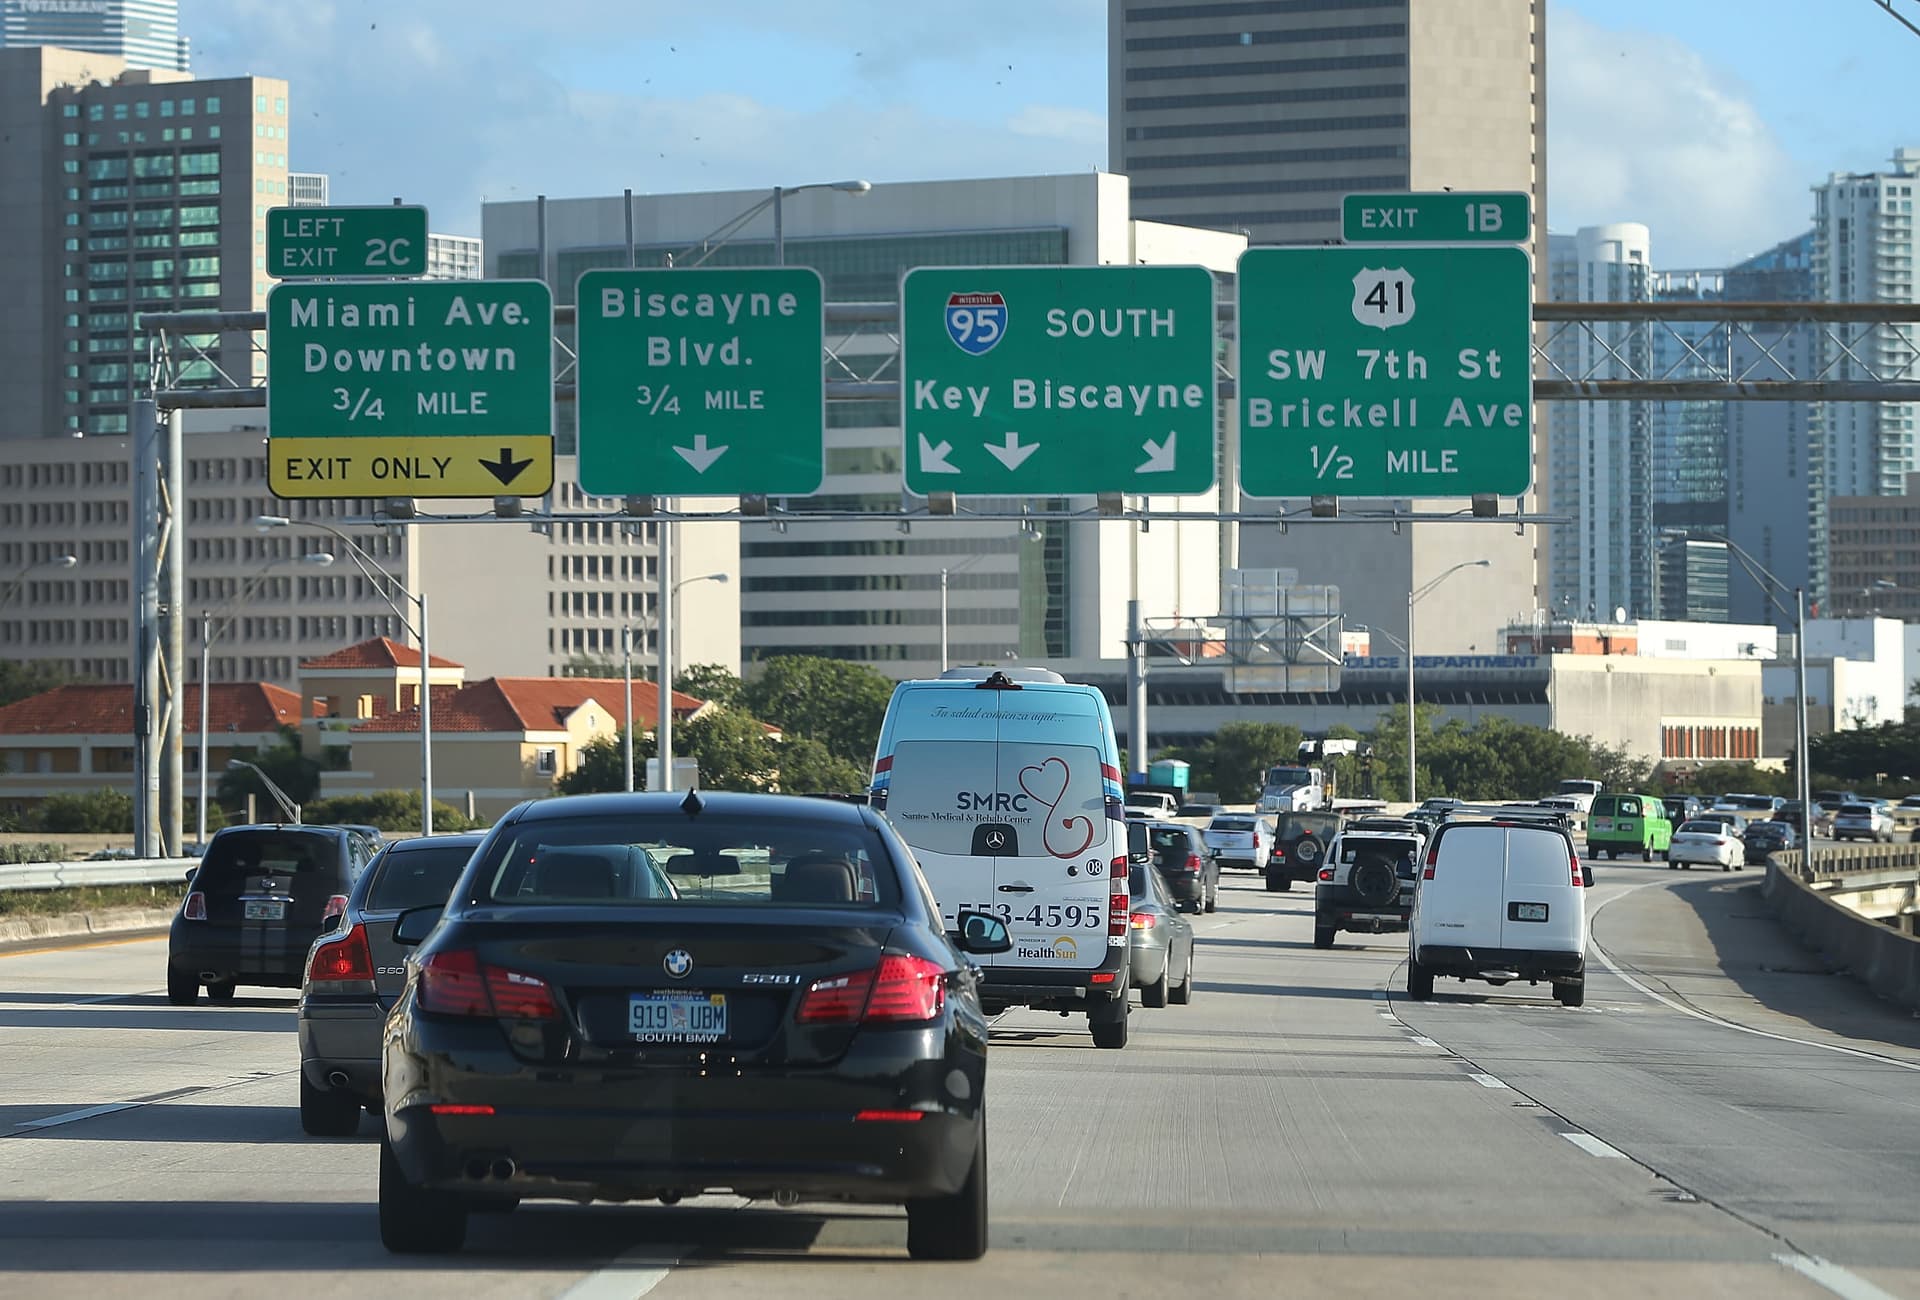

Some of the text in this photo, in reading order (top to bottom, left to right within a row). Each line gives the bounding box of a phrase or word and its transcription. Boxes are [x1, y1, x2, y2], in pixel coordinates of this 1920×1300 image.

[284, 218, 344, 237] LEFT
[1362, 204, 1502, 231] EXIT 1B
[284, 239, 409, 266] EXIT 2C
[602, 288, 797, 324] Biscayne
[958, 296, 993, 304] INTERSTATE
[1364, 281, 1403, 313] 41
[292, 297, 529, 327] Miami Ave.
[1047, 309, 1173, 337] SOUTH
[952, 309, 998, 343] 95
[305, 343, 515, 372] Downtown
[648, 337, 752, 366] Blvd.
[1268, 349, 1500, 379] SW 7th St
[334, 388, 487, 420] 3/4 MILE
[638, 385, 763, 415] 3/4 MILE
[915, 379, 1202, 416] Key Biscayne
[1250, 398, 1522, 427] Brickell Ave
[288, 457, 451, 479] EXIT ONLY
[1311, 446, 1458, 478] 1/2 MILE
[1406, 656, 1538, 668] DEPARTMENT
[950, 707, 982, 719] salud
[957, 791, 1028, 812] SMRC
[931, 812, 964, 821] Medical
[976, 813, 1003, 822] Rehab
[1004, 814, 1031, 824] Center
[1087, 861, 1102, 875] 08
[1018, 947, 1077, 959] HealthSun
[377, 967, 405, 975] S60
[633, 1005, 724, 1030] 919 UBM
[636, 1033, 718, 1043] SOUTH BMW
